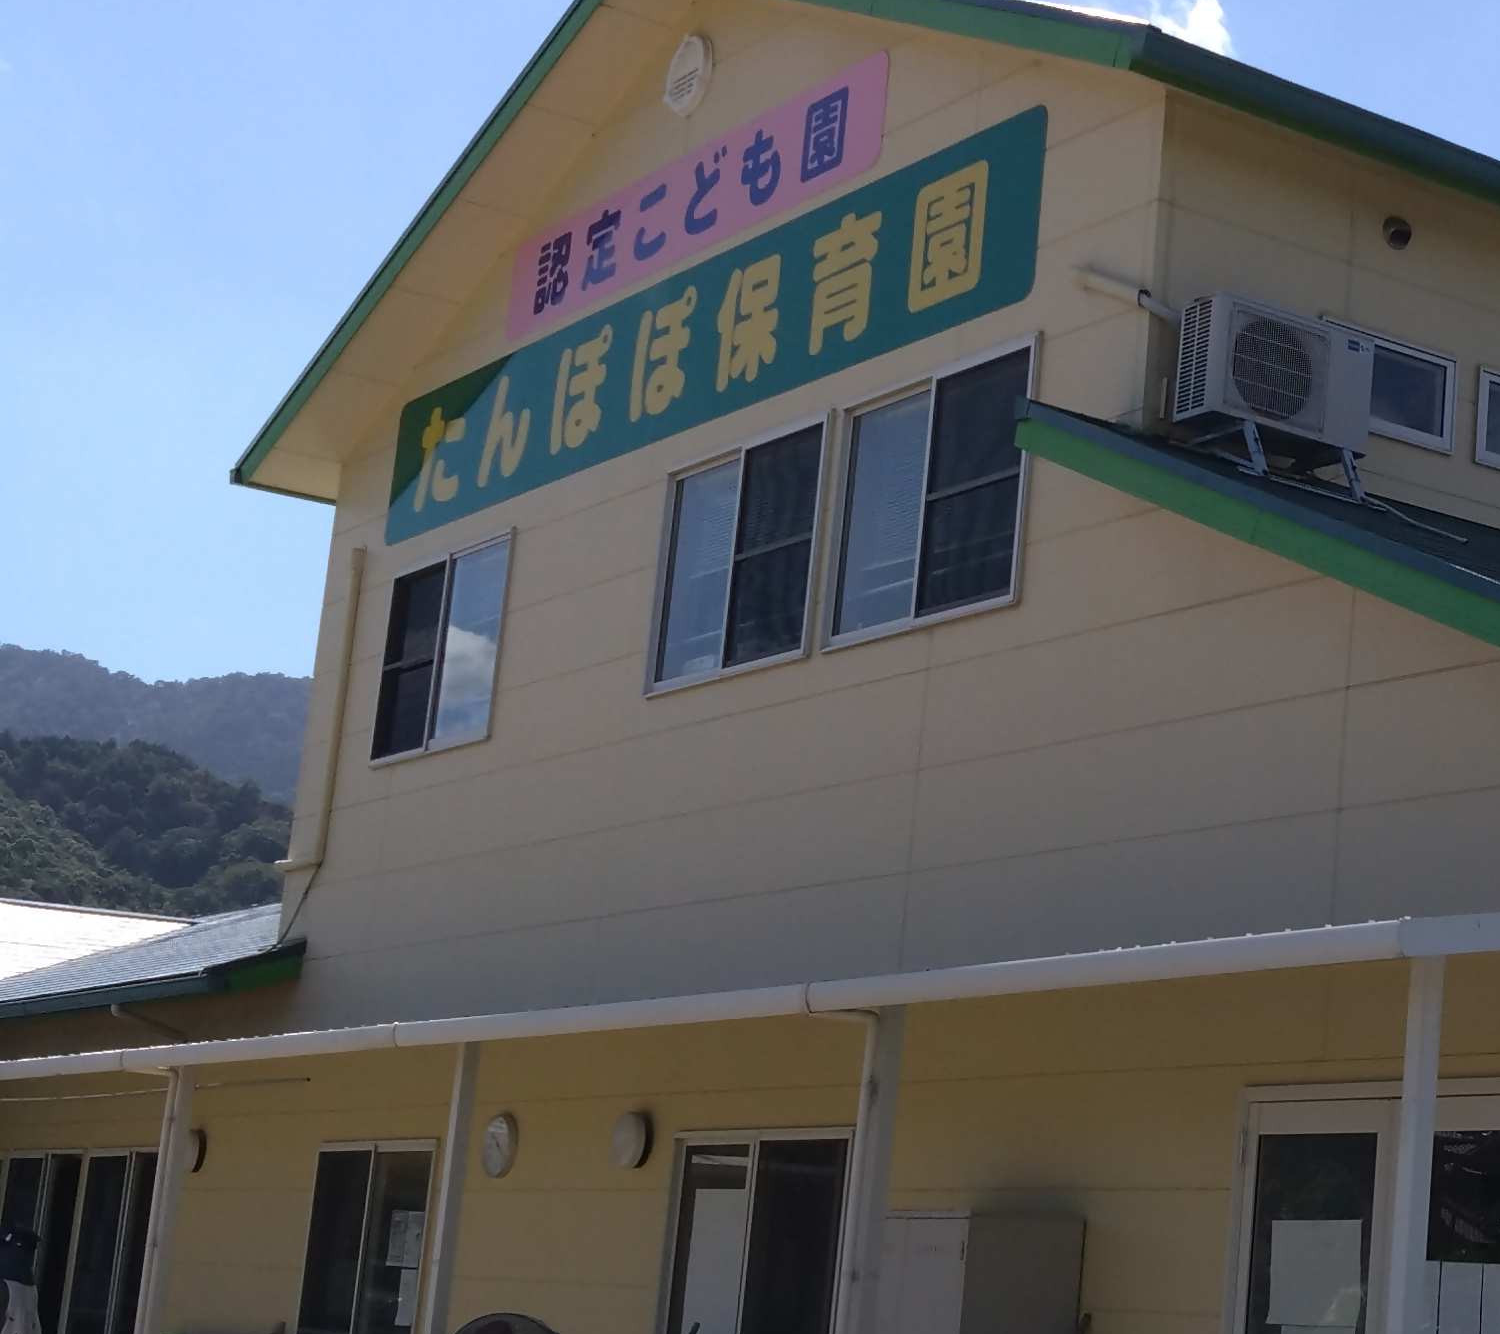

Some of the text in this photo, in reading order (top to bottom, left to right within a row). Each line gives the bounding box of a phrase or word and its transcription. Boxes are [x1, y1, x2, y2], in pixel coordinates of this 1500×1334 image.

[414, 159, 989, 512] たんぽぽ保育園
[533, 85, 850, 316] 認定こども園
